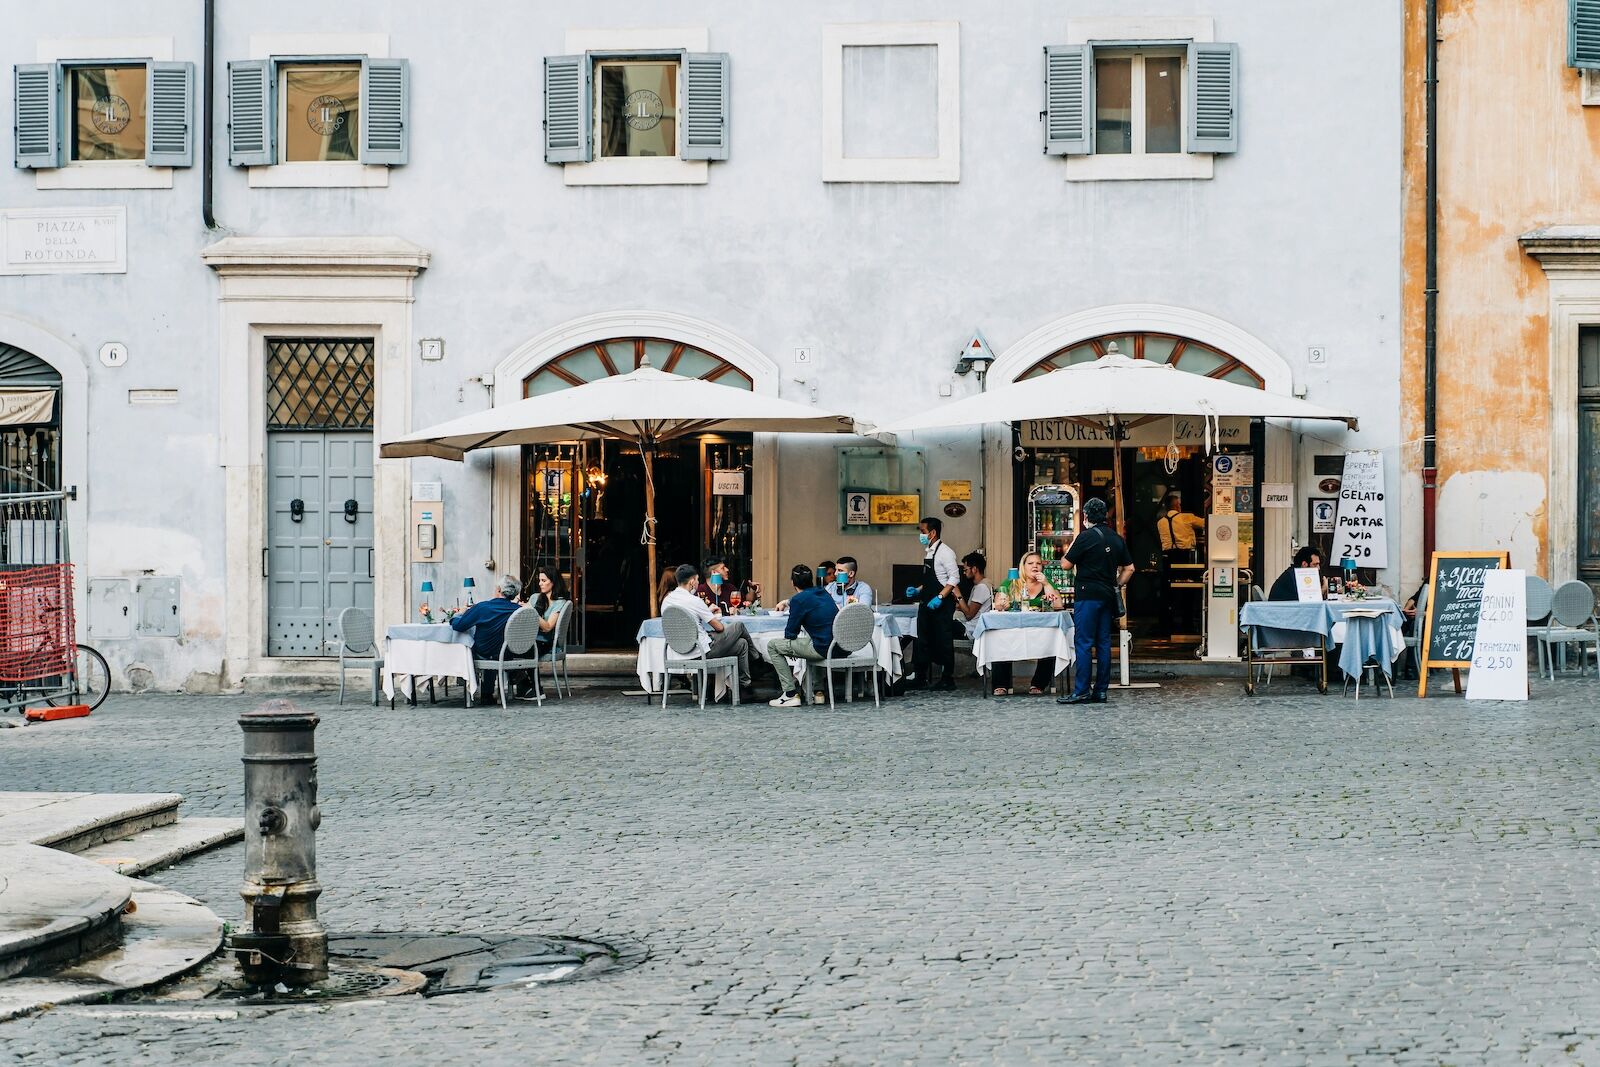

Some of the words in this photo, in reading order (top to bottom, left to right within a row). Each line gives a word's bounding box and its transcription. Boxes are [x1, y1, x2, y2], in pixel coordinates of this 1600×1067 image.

[105, 107, 118, 121] IL
[321, 107, 333, 122] IL
[637, 102, 650, 118] IL
[37, 221, 86, 233] PIAZZA
[45, 237, 78, 246] DELLA
[24, 249, 97, 260] ROTONDA
[110, 347, 118, 361] 6
[428, 344, 435, 354] 7
[799, 350, 806, 361] 8
[1312, 349, 1321, 361] 9
[717, 482, 739, 490] USCITA
[1341, 489, 1384, 501] GELATO
[1355, 504, 1366, 513] A
[1339, 516, 1384, 527] PORTAR
[1482, 595, 1515, 609] PANINI
[1479, 642, 1521, 652] TRAMEZZINI
